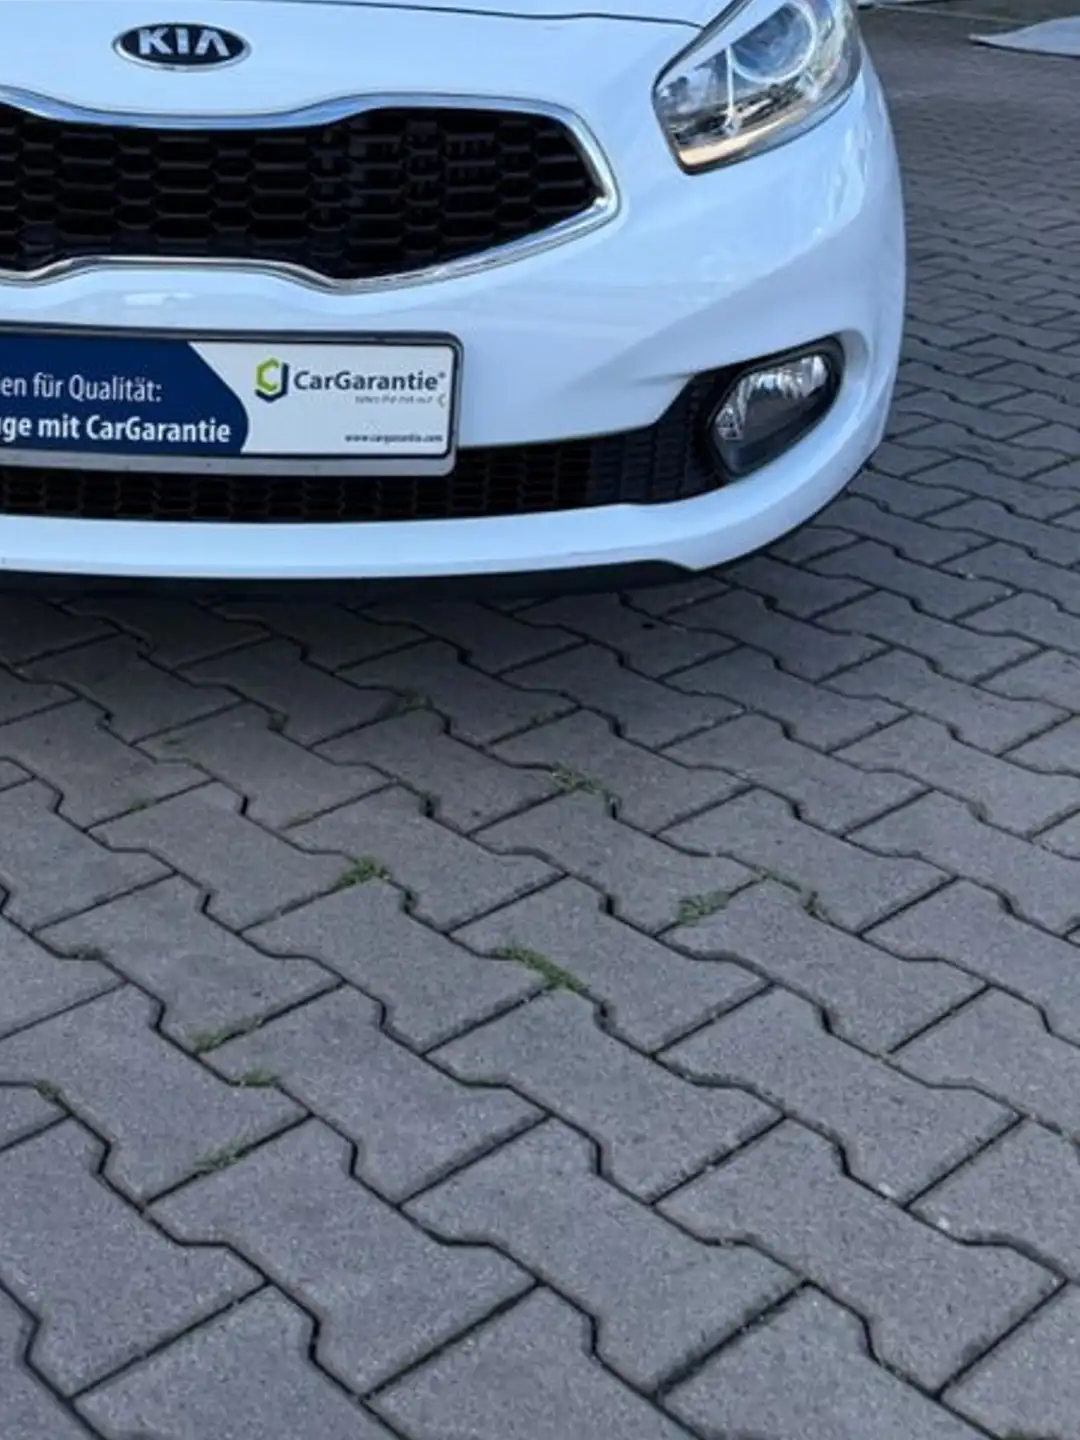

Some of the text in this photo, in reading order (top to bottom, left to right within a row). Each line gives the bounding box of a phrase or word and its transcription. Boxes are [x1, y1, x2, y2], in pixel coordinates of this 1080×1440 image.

[138, 27, 230, 56] KIA
[33, 371, 64, 399] für
[69, 373, 163, 403] Qualität:
[37, 413, 80, 439] mit
[85, 413, 232, 444] CarGarantie
